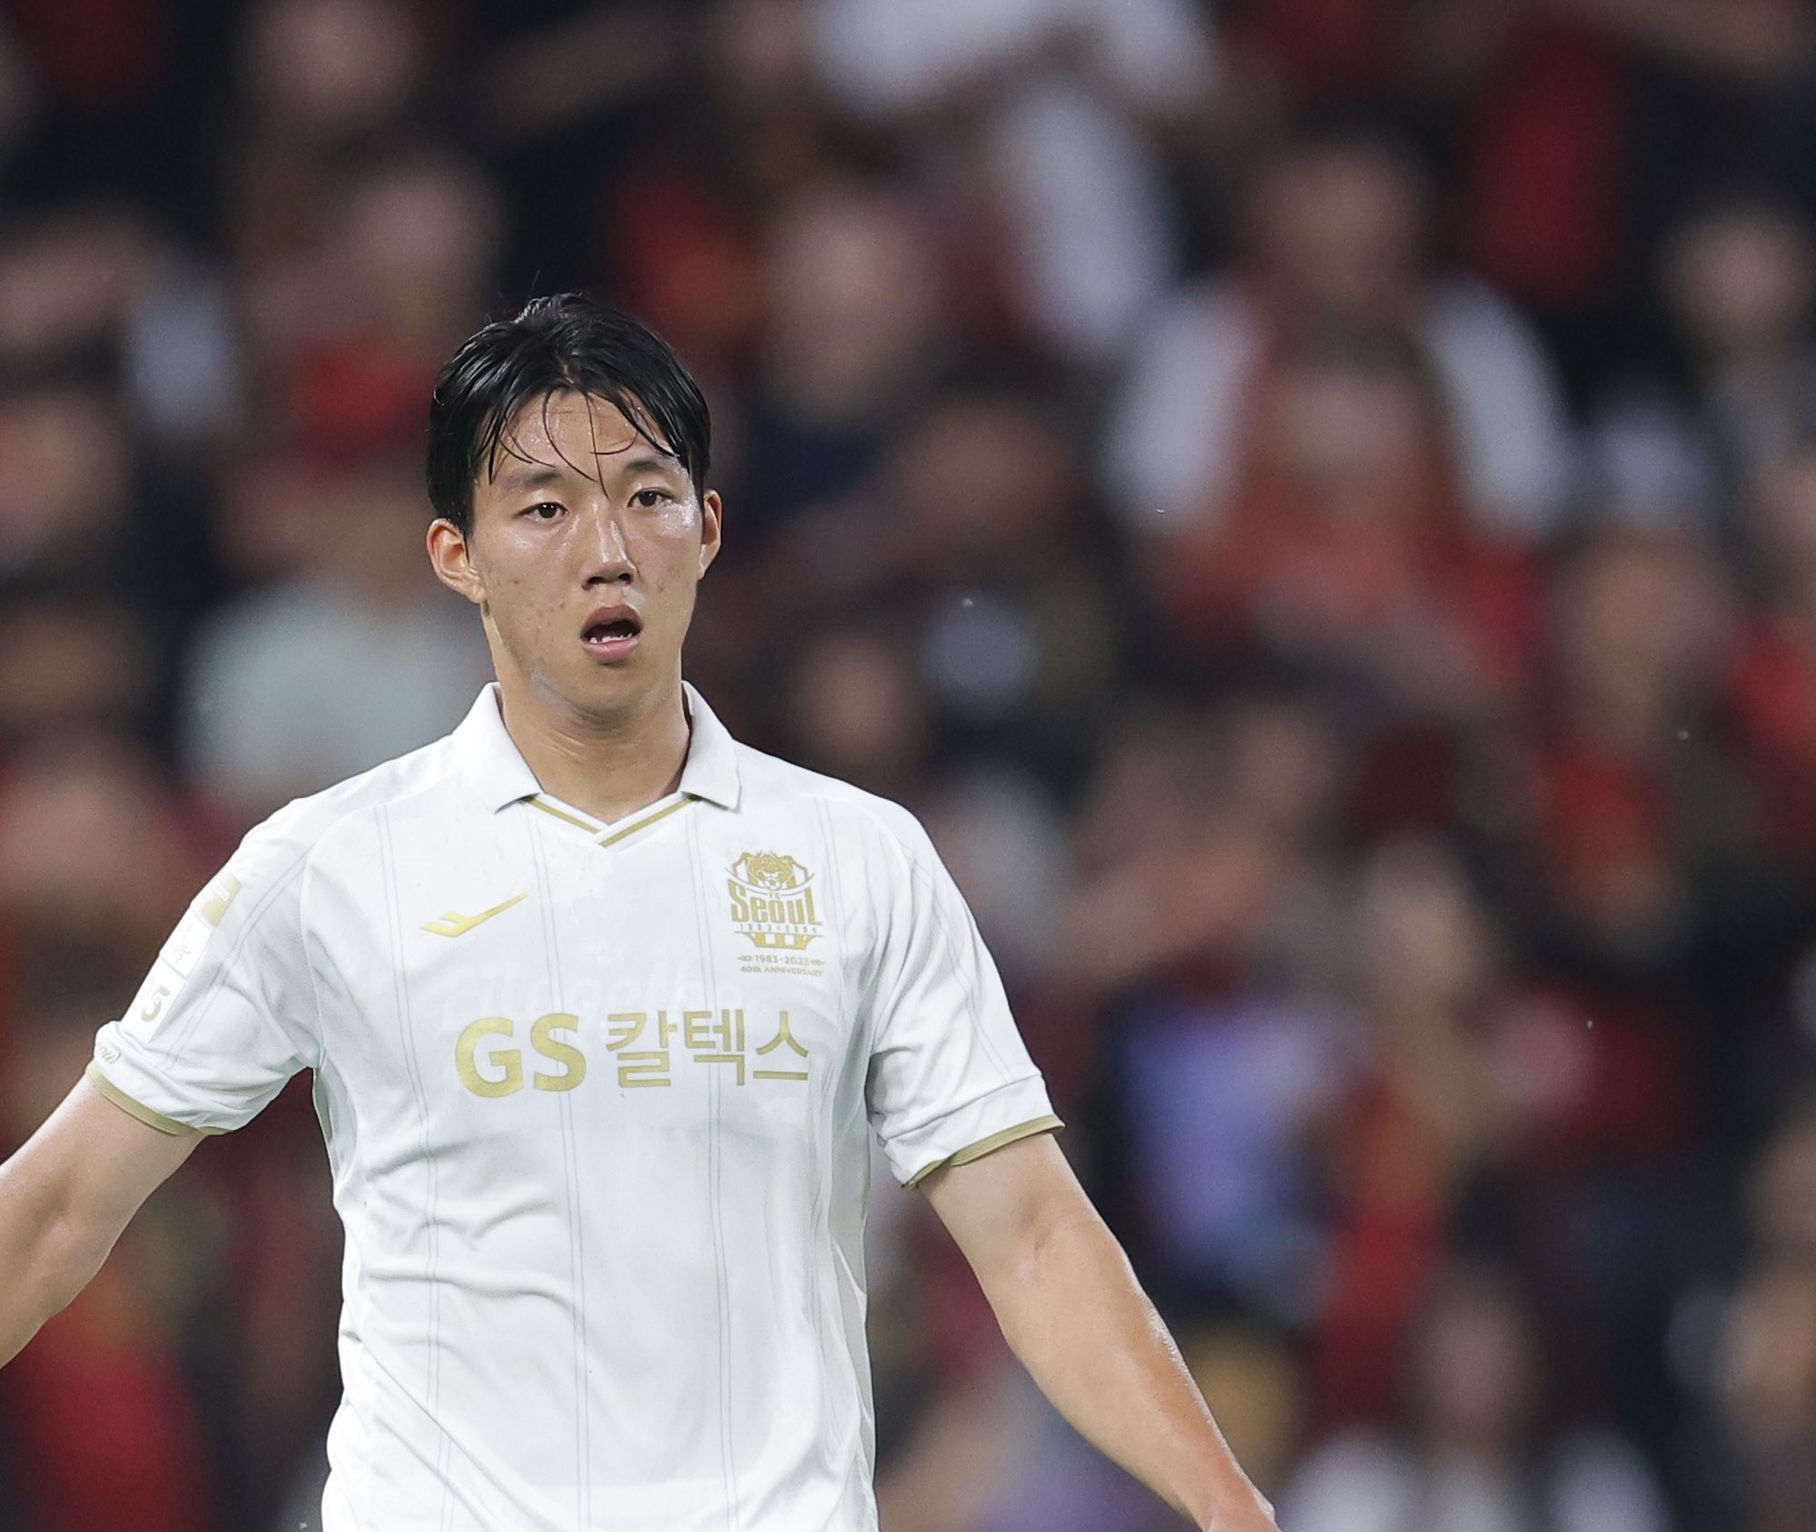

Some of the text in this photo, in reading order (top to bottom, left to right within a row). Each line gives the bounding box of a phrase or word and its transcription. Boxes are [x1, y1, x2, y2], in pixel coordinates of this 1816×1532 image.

[728, 878, 822, 925] Seoul
[455, 1008, 810, 1098] GS 칼텍스
